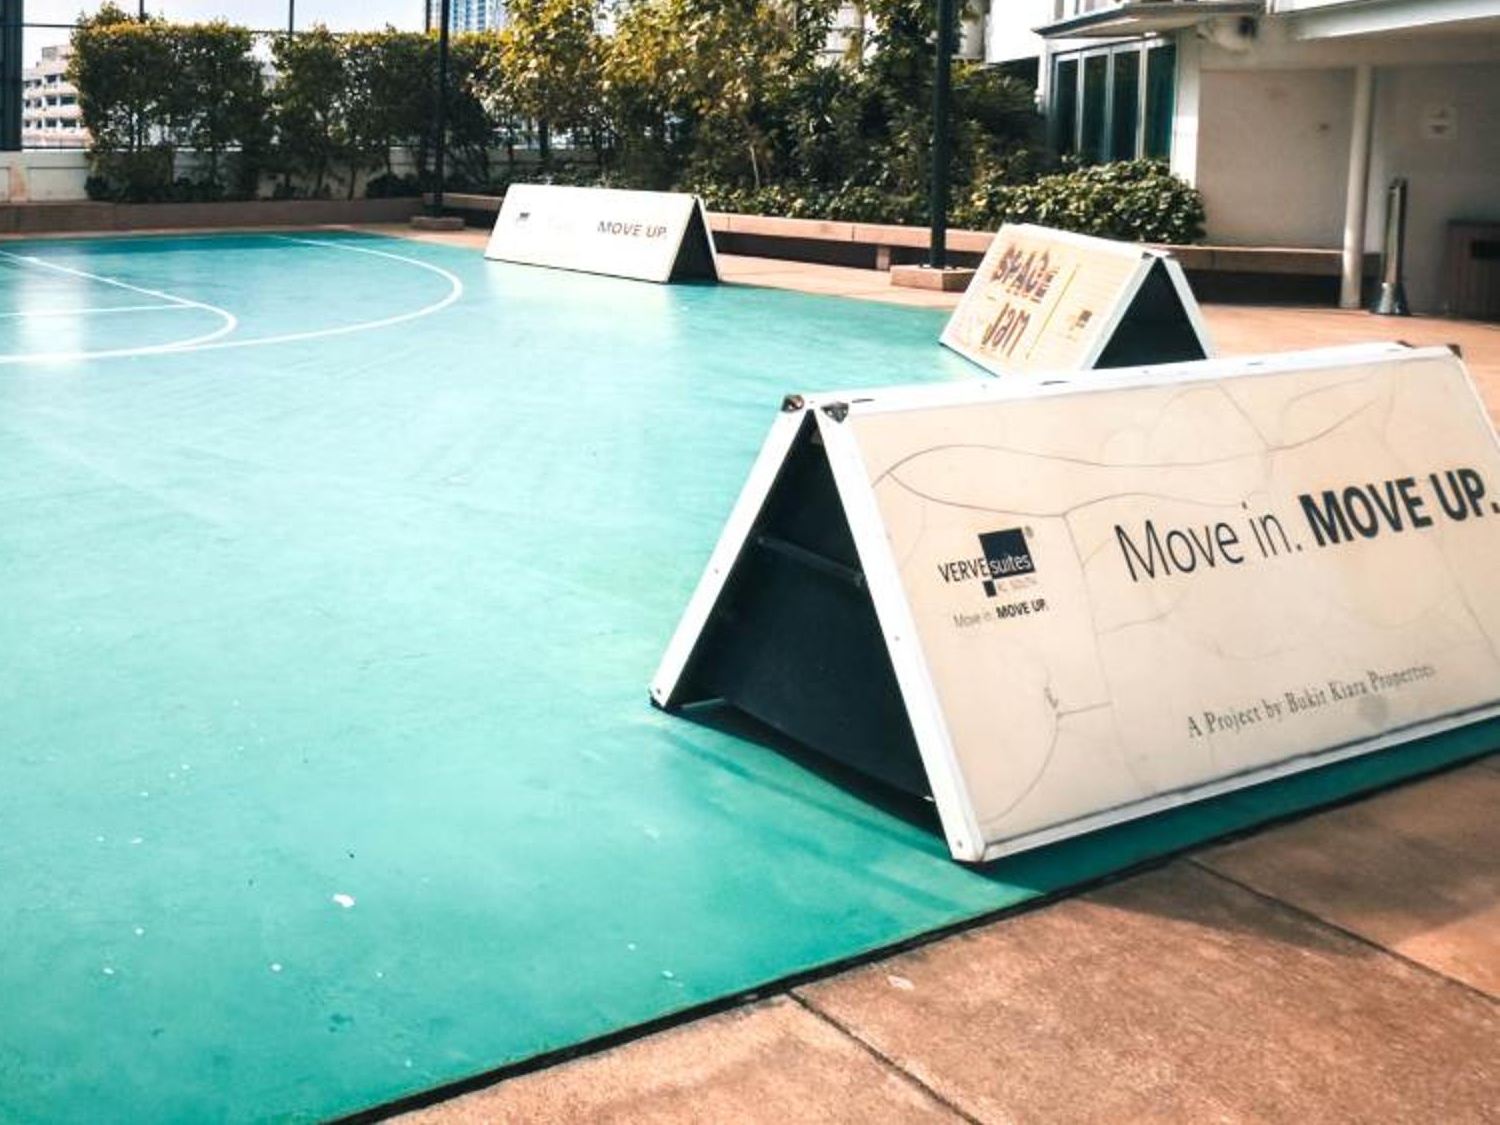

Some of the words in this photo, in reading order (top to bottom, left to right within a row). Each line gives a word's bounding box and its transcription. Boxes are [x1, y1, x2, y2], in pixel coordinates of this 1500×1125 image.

[597, 220, 643, 237] MOVE
[1114, 519, 1245, 582] Move
[1240, 500, 1304, 558] in.
[1297, 477, 1434, 548] MOVE
[1429, 467, 1500, 522] UP.
[937, 557, 989, 583] VERVE
[995, 602, 1031, 619] MOVE
[1187, 715, 1203, 738] A
[1203, 708, 1262, 734] Project
[1261, 698, 1285, 722] by
[1284, 689, 1328, 714] Bukit
[1328, 679, 1367, 701] Kiara
